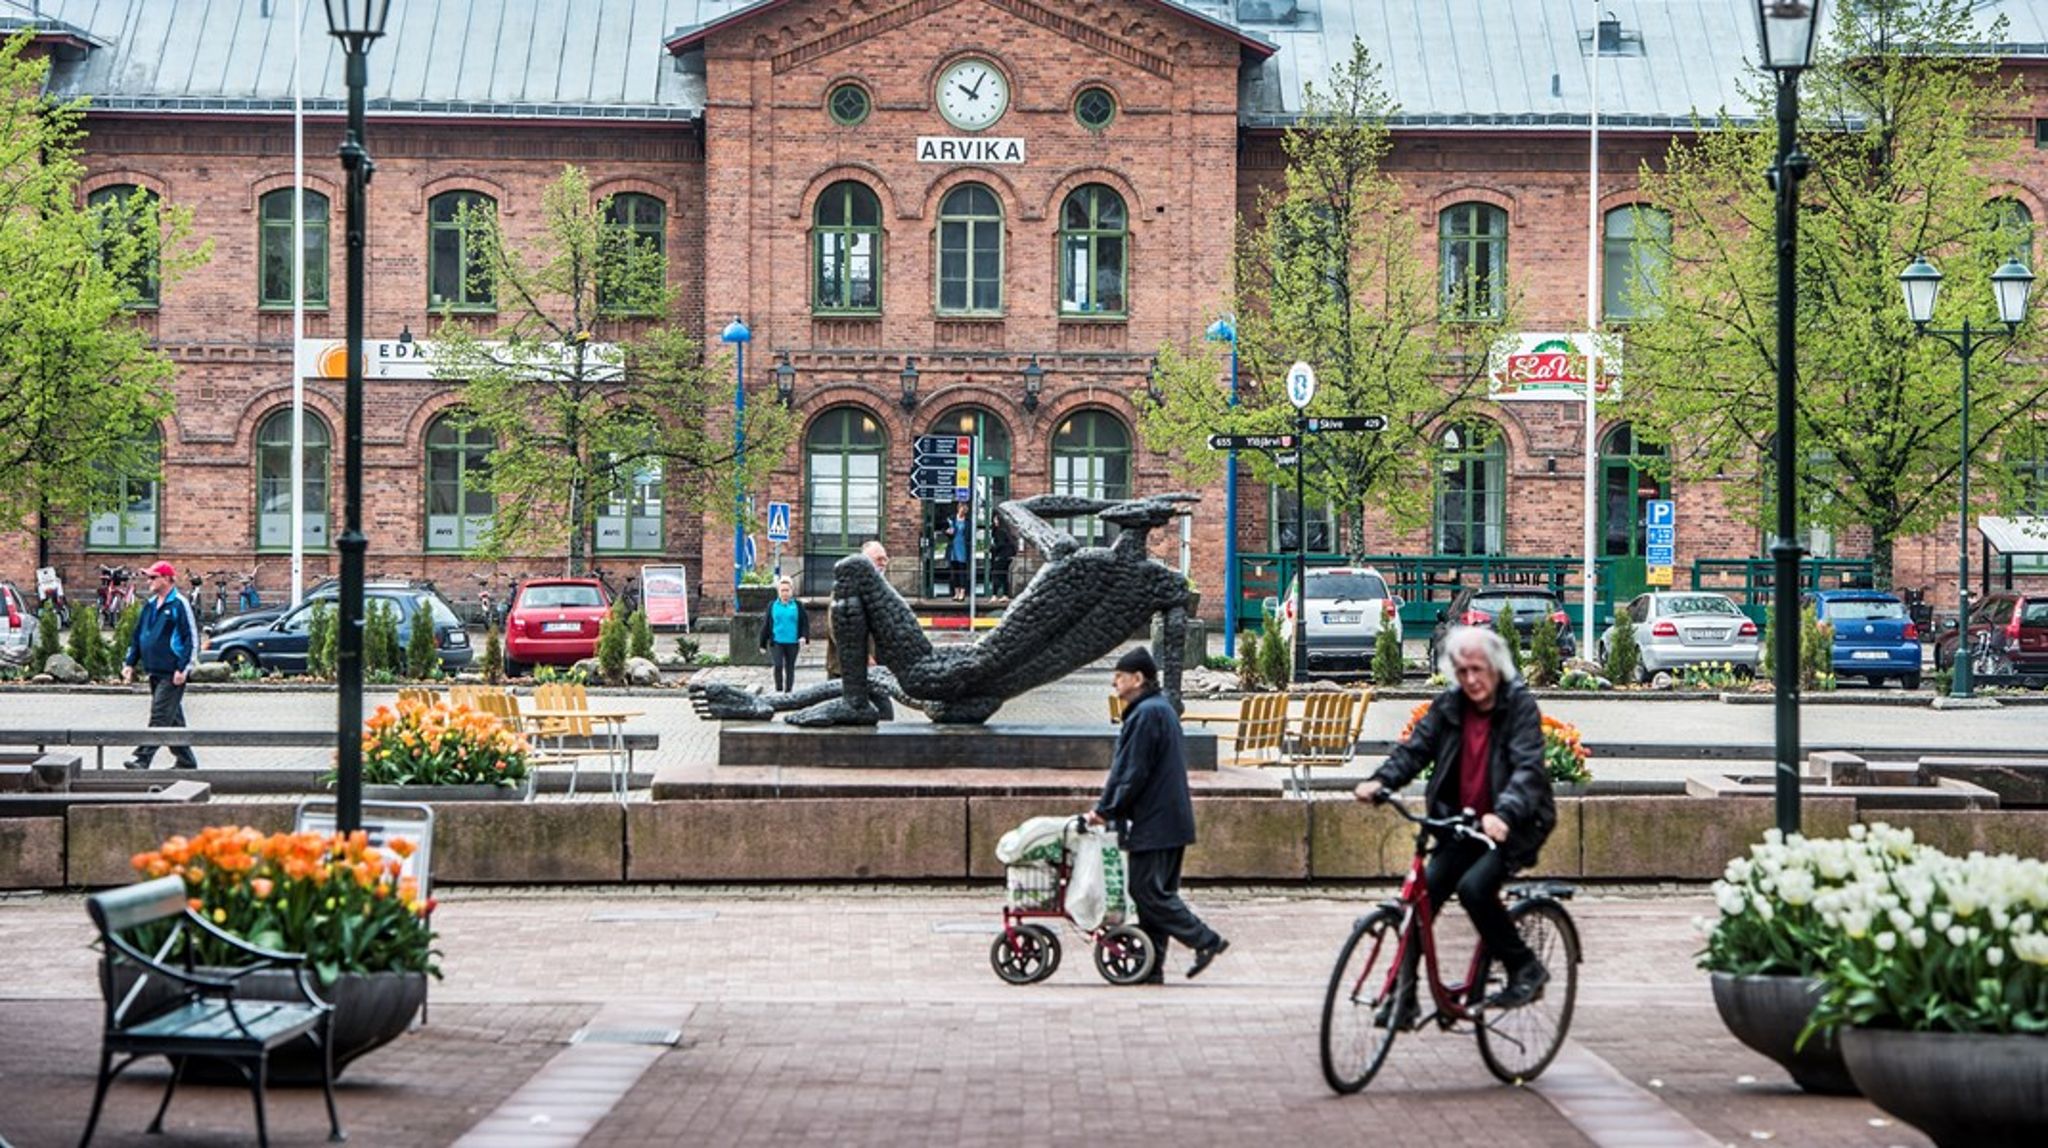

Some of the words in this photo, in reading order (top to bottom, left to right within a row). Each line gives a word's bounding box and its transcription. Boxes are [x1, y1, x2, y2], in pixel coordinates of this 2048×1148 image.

[921, 141, 1021, 160] ARVIKA
[1319, 420, 1344, 429] Skive
[1364, 420, 1380, 428] 429
[1216, 437, 1232, 446] 655
[1653, 504, 1670, 523] P
